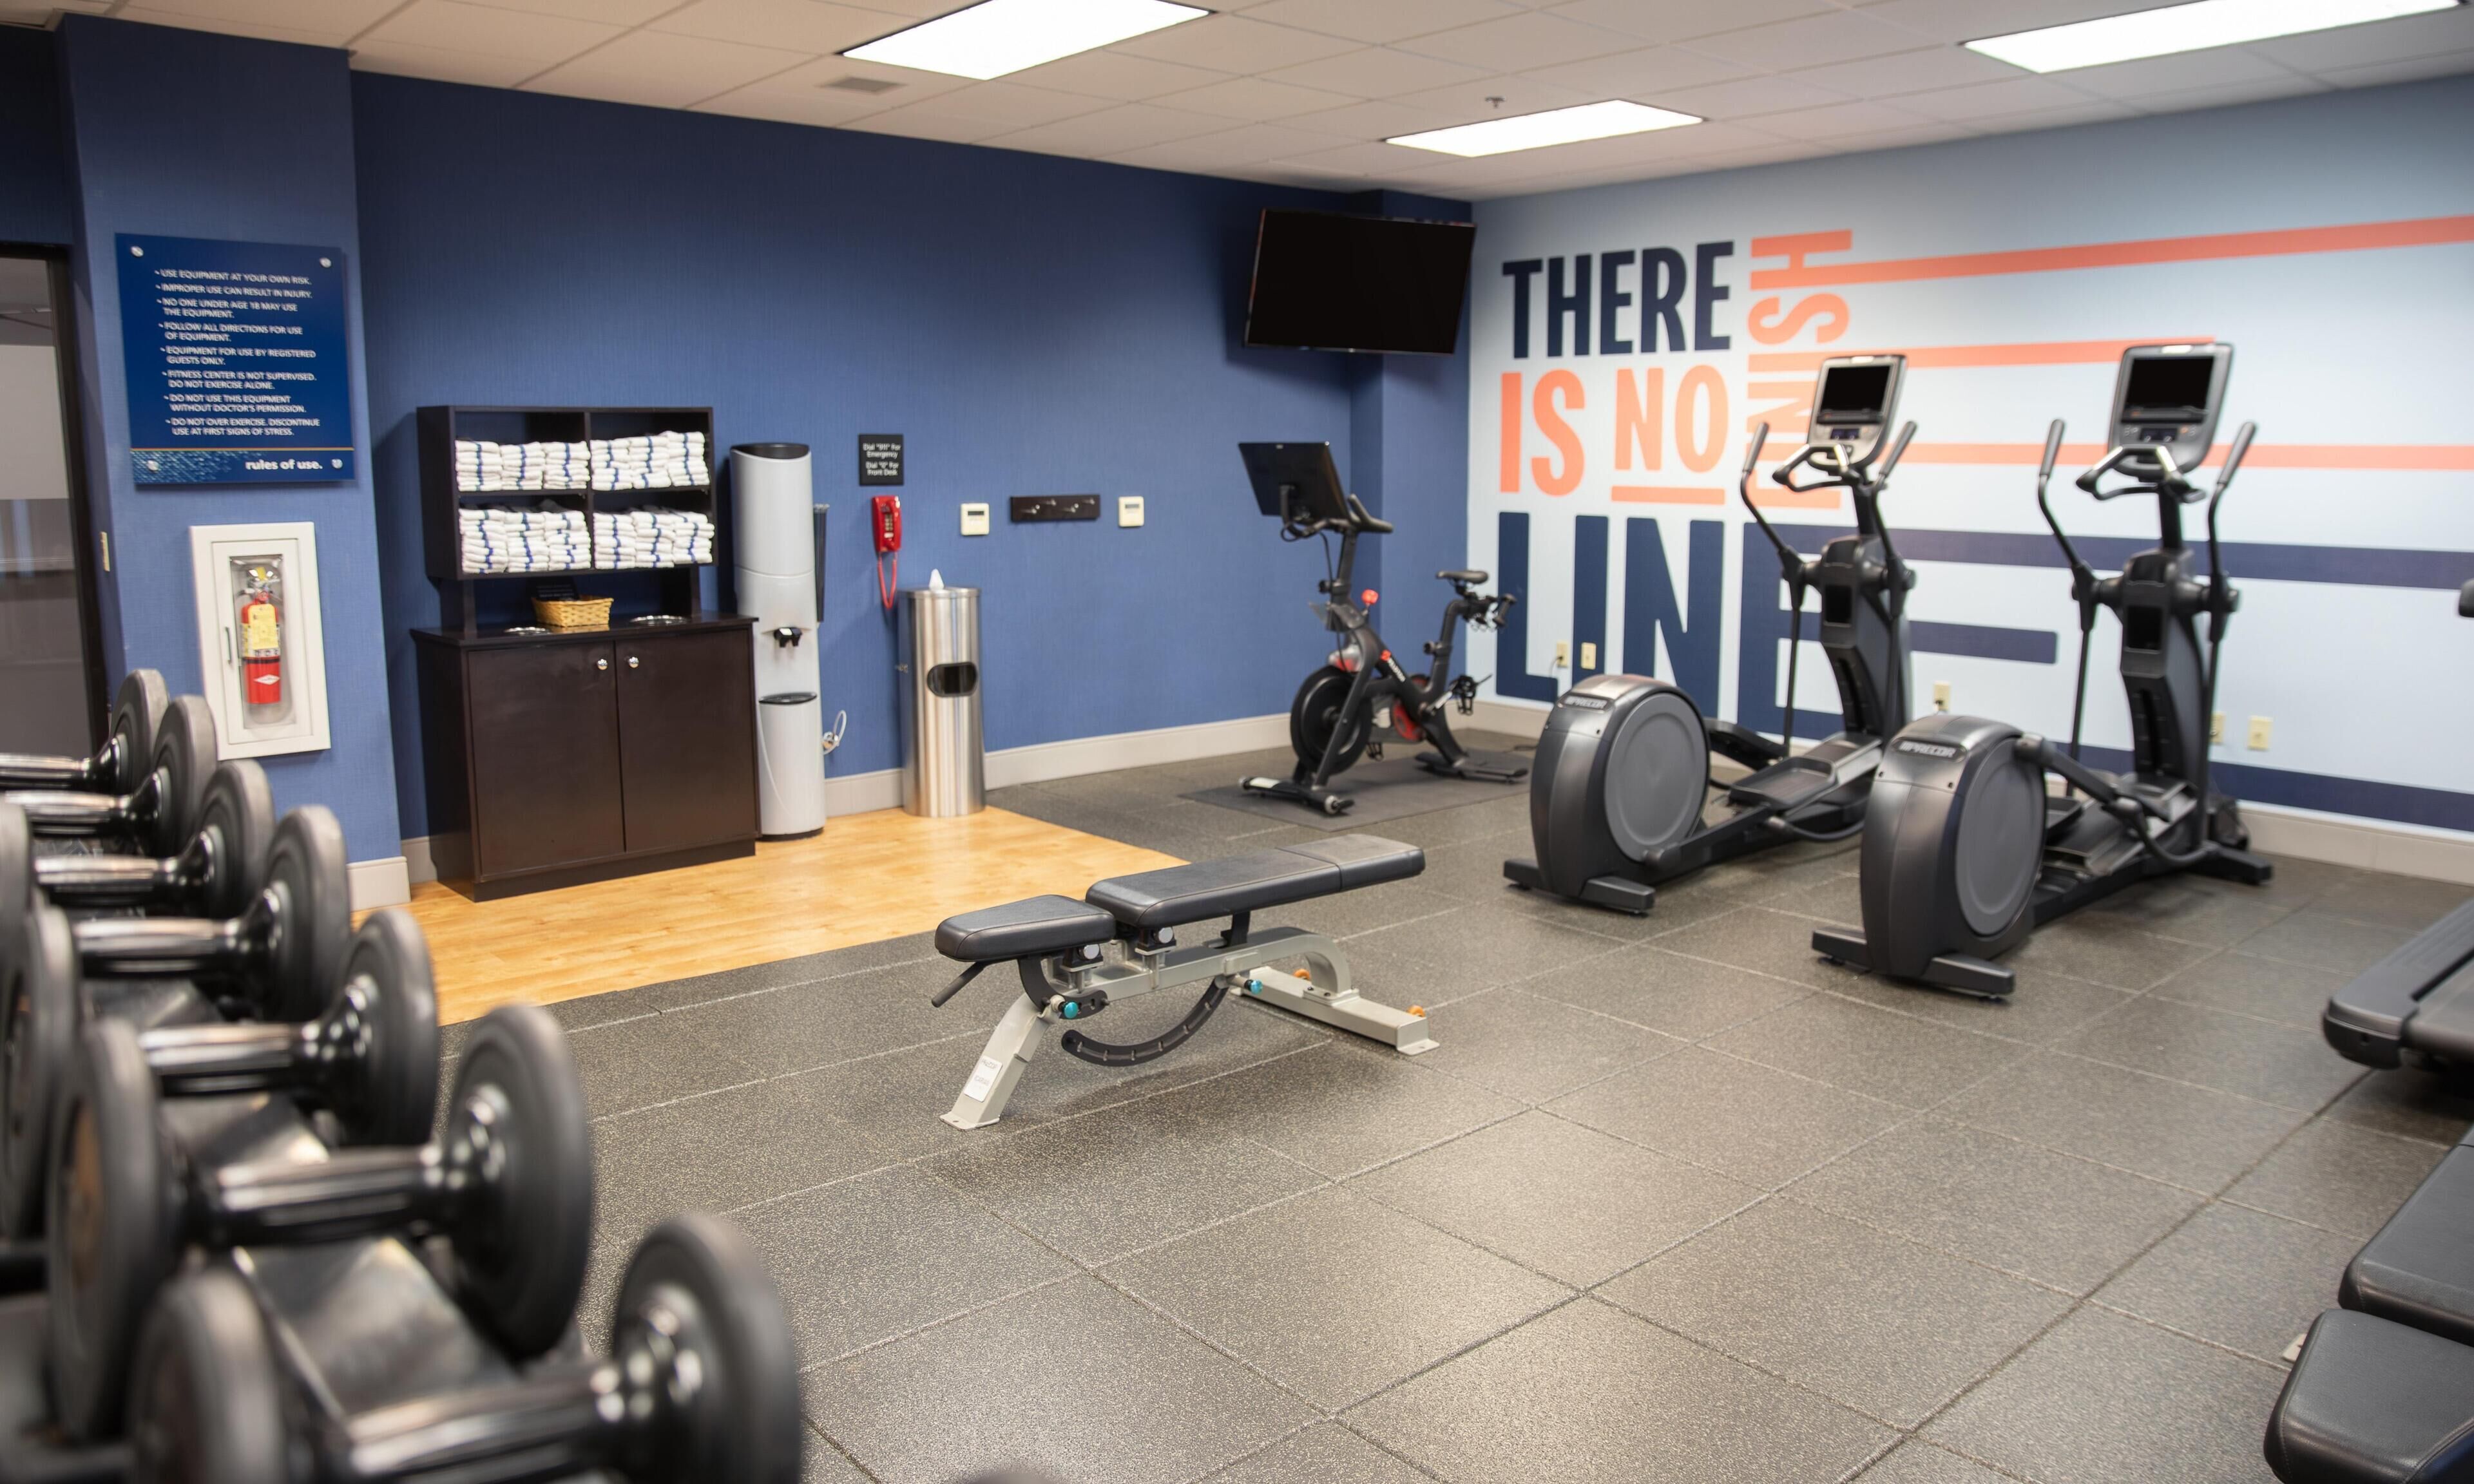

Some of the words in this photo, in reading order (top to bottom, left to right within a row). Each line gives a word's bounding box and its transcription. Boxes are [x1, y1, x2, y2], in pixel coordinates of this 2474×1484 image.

[160, 269, 178, 278] USE
[178, 269, 229, 280] EQUIPMENT
[230, 272, 242, 281] AT
[242, 273, 268, 283] YOUR
[268, 274, 291, 283] OWN
[291, 276, 312, 285] RISK.
[160, 283, 206, 293] IMPROPER
[206, 285, 223, 294] USE
[223, 286, 242, 295] CAN
[242, 287, 272, 296] RESULT
[273, 289, 282, 297] IN
[283, 289, 312, 298] INJURY.
[162, 297, 177, 306] NO
[178, 298, 198, 307] ONE
[198, 299, 229, 309] UNDER
[229, 300, 249, 309] AGE
[249, 301, 260, 310] 18
[260, 301, 281, 310] MAY
[281, 303, 298, 312] USE
[1502, 240, 1734, 359] THERE
[163, 307, 181, 316] THE
[182, 308, 235, 318] EQUIPMENT.
[164, 321, 202, 331] FOLLOW
[202, 323, 219, 332] ALL
[219, 323, 269, 334] DIRECTIONS
[269, 325, 287, 334] FOR
[287, 326, 303, 335] USE
[164, 331, 178, 340] OF
[178, 332, 231, 341] EQUIPMENT.
[166, 345, 218, 355] EQUIPMENT
[218, 347, 237, 356] FOR
[237, 348, 254, 356] USE
[254, 348, 267, 356] BY
[267, 348, 316, 358] REGISTERED
[166, 356, 200, 364] GUESTS
[200, 356, 225, 365] ONLY.
[167, 370, 202, 378] FITNESS
[202, 370, 236, 379] CENTER
[236, 371, 245, 379] IS
[245, 372, 265, 380] NOT
[265, 372, 317, 381] SUPERVISED.
[168, 379, 184, 388] DO
[184, 379, 204, 388] NOT
[204, 380, 243, 388] EXERCISE
[244, 381, 275, 390] ALONE.
[169, 393, 184, 402] DO
[185, 394, 205, 402] NOT
[205, 394, 222, 403] USE
[222, 394, 242, 403] THIS
[242, 395, 291, 404] EQUIPMENT
[169, 403, 212, 412] WITHOUT
[213, 404, 256, 412] DOCTOR'S
[256, 404, 307, 413] PERMISSION.
[171, 417, 186, 426] DO
[186, 417, 206, 426] NOT
[206, 417, 229, 426] OVER
[229, 418, 268, 426] EXERCISE.
[171, 427, 189, 435] USE
[190, 427, 202, 435] AT
[202, 427, 225, 435] FIRST
[1499, 368, 1586, 498] IS
[1614, 365, 1729, 473] NO
[245, 459, 278, 470] rules
[280, 459, 295, 470] of
[296, 460, 323, 470] use.
[889, 461, 899, 470] For
[1908, 741, 1957, 757] PRECOR
